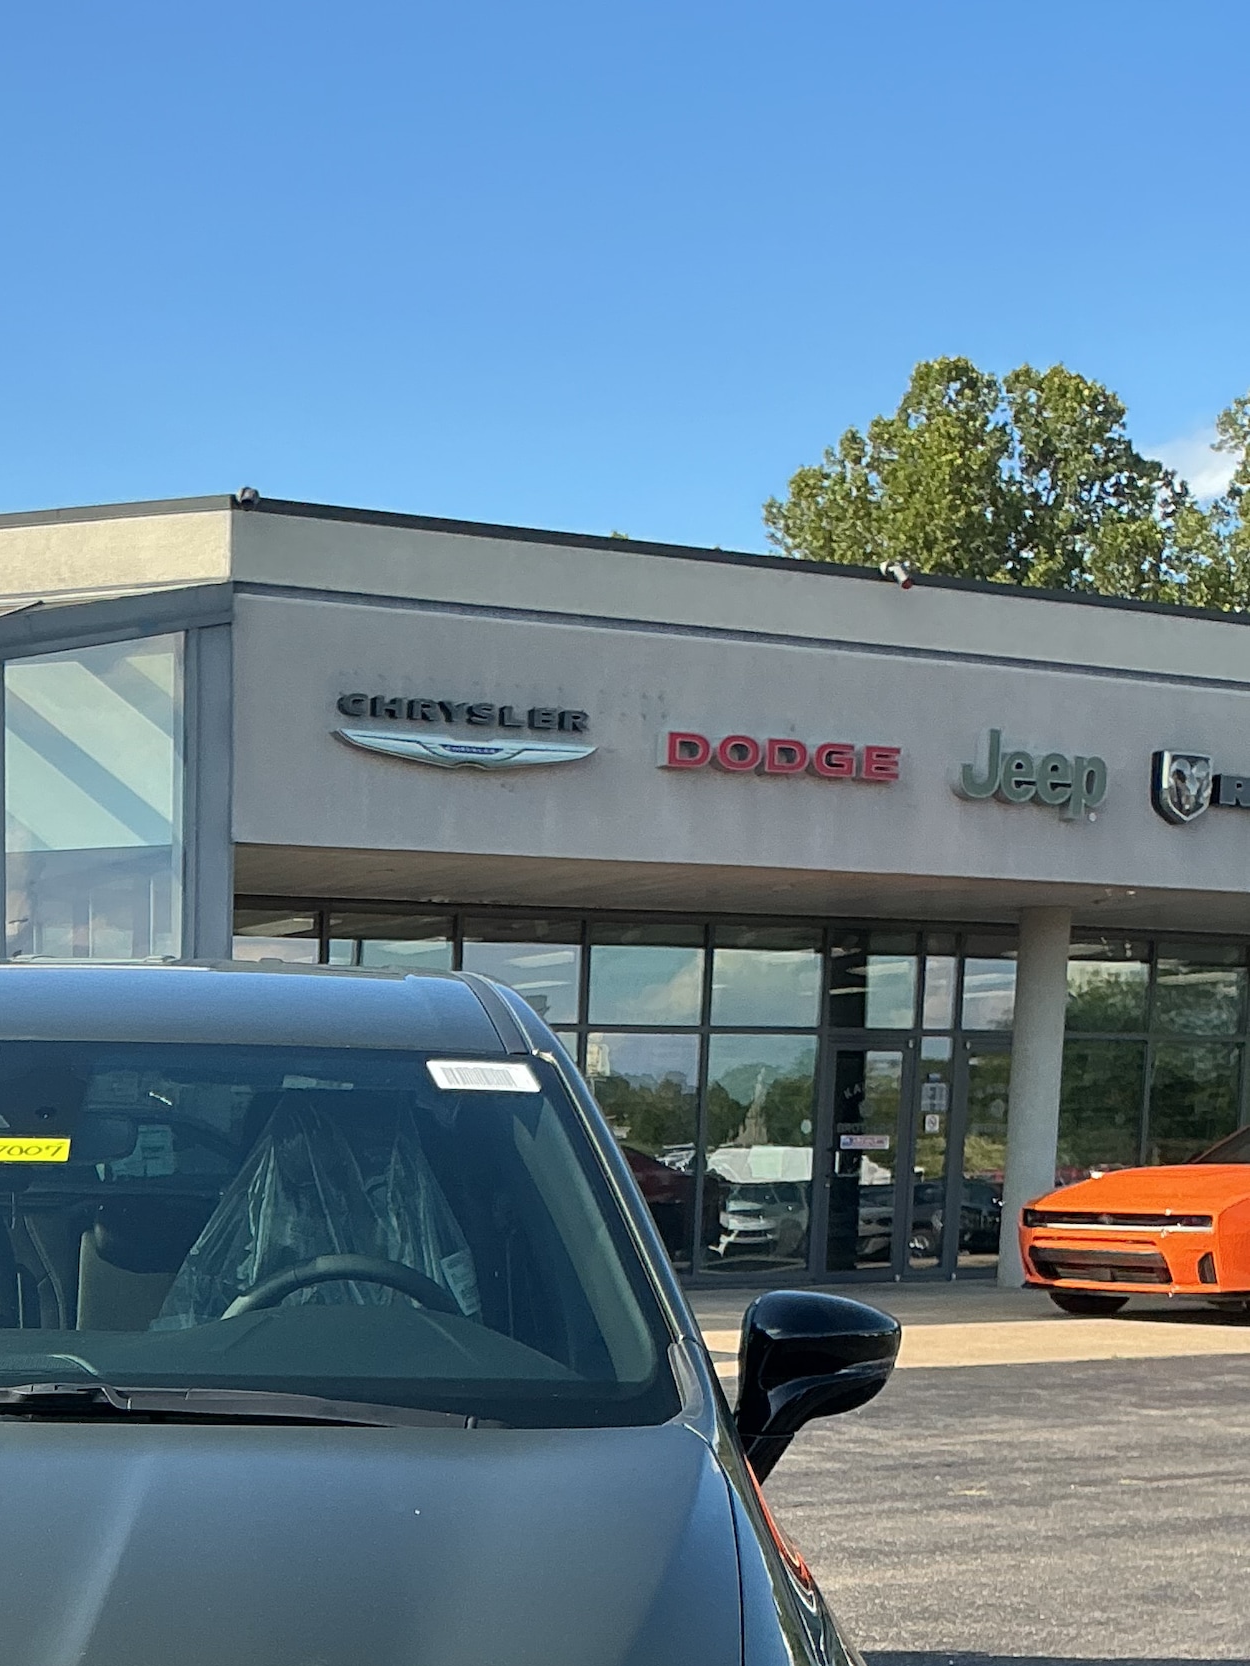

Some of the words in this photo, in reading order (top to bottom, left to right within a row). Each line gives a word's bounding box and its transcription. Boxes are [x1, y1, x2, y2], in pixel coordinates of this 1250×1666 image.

[337, 692, 590, 732] CHRYSLER
[664, 730, 901, 781] DODGE
[959, 727, 1108, 821] Jeep
